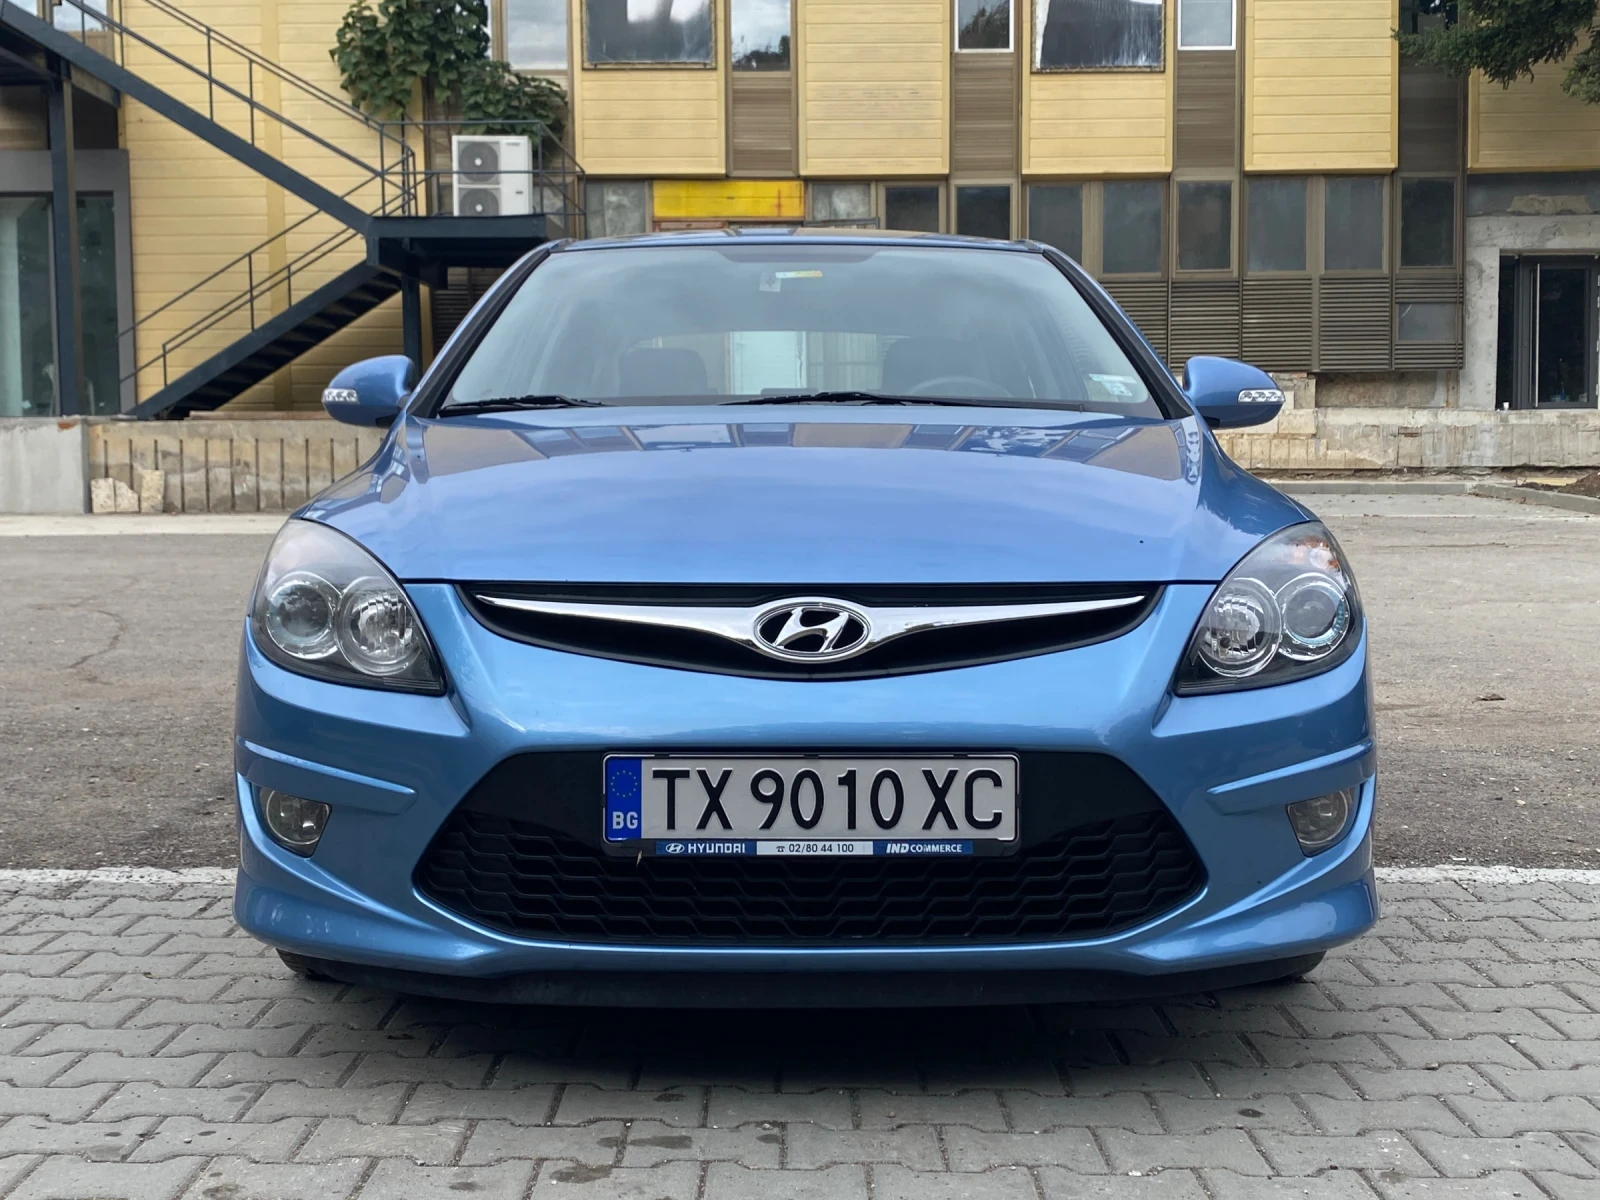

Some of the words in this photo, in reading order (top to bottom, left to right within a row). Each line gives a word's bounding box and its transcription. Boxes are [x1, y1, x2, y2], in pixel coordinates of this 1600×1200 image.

[652, 768, 733, 830] TX
[750, 768, 904, 830] 9010
[921, 768, 1002, 830] XC
[612, 811, 638, 829] BG
[687, 843, 745, 854] HYUNDAI
[788, 843, 818, 854] 02/80
[820, 843, 832, 853] 44
[836, 843, 854, 853] 100
